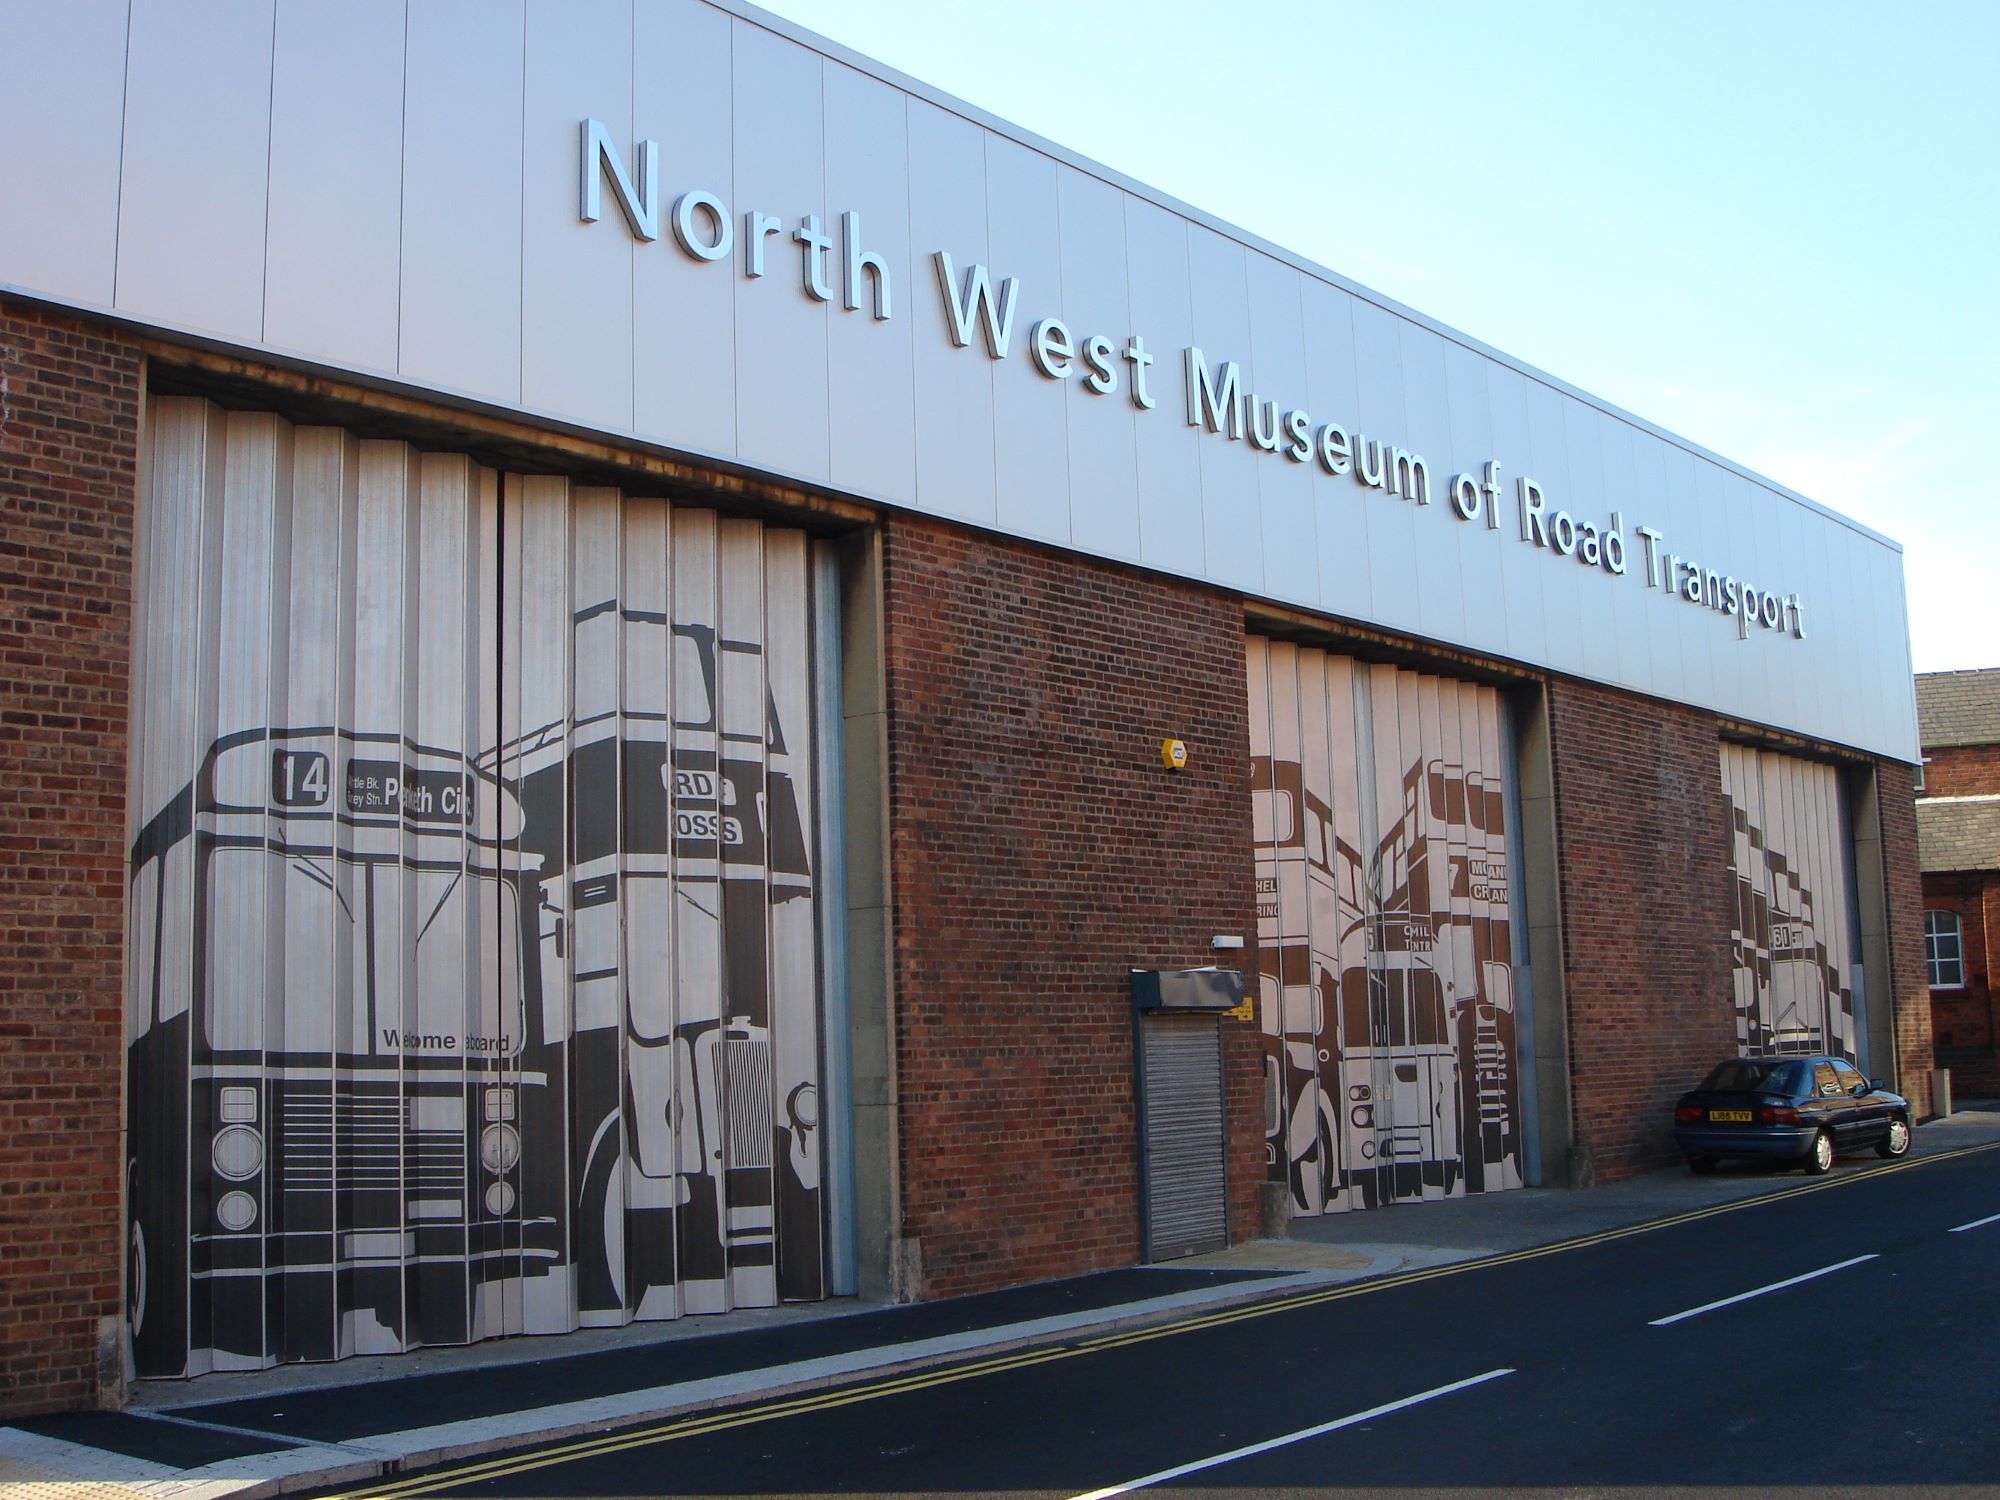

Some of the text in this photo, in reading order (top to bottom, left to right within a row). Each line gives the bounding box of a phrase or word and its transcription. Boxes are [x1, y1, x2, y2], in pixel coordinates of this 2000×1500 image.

[579, 118, 1806, 640] North West Museum of Road Transport
[284, 755, 327, 801] 14
